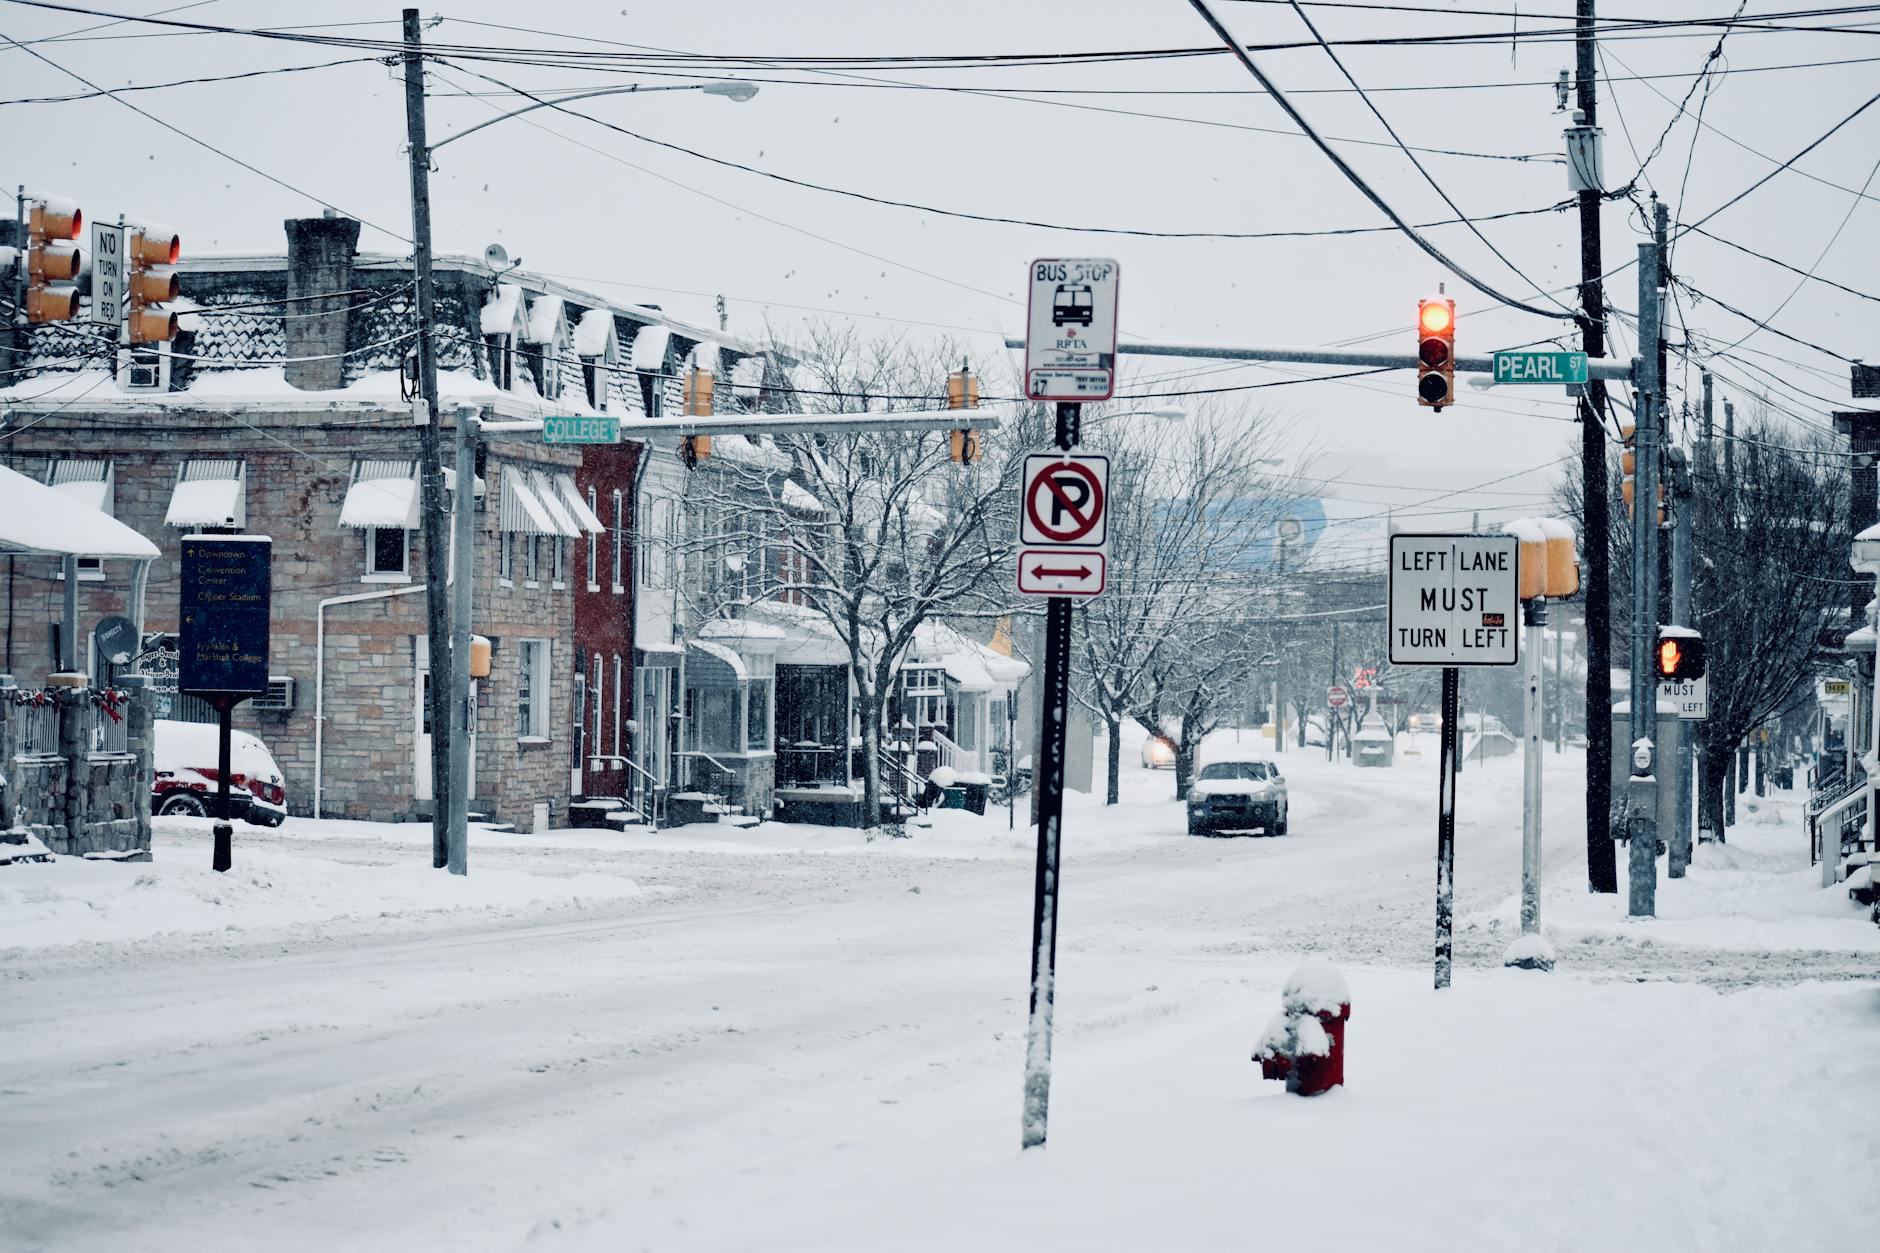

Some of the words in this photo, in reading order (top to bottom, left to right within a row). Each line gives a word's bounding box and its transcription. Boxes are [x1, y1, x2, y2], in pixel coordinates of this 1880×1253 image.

[100, 232, 116, 255] NO
[99, 259, 117, 277] TURN
[1037, 264, 1067, 281] BUS
[1074, 264, 1112, 281] STOP
[103, 281, 113, 297] ON
[101, 301, 115, 318] RED
[1498, 356, 1563, 379] PEARL
[1569, 356, 1583, 369] ST
[1033, 379, 1047, 396] 17
[545, 420, 608, 439] COLLEGE
[199, 549, 245, 559] Downtown
[1402, 552, 1447, 571] LEFT
[1460, 552, 1508, 571] LANE
[198, 565, 246, 575] Convention
[198, 576, 227, 586] Center
[230, 592, 261, 602] Stadium
[1421, 588, 1488, 612] MUST
[1399, 628, 1446, 648] TURN
[1463, 628, 1509, 649] LEFT
[1664, 685, 1695, 696] MUST
[1682, 702, 1703, 712] LEFT
